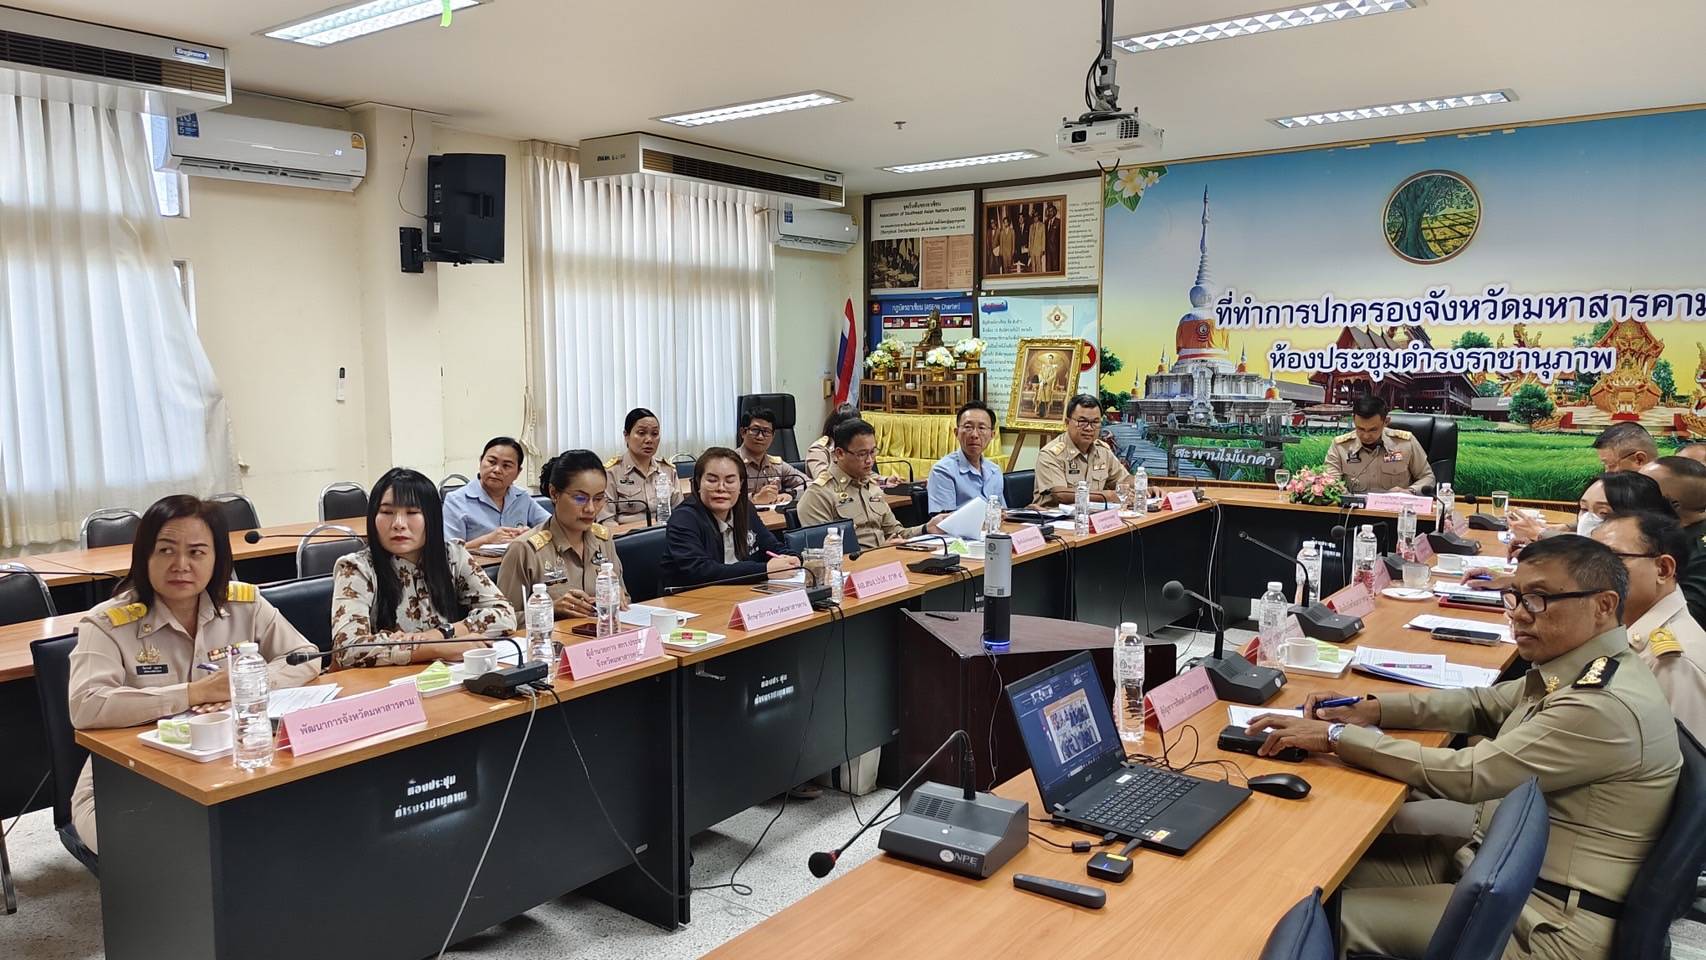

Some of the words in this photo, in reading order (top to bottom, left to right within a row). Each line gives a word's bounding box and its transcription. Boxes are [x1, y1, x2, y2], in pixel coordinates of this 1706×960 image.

[1270, 344, 1612, 378] ห้องประชุมดำรงราชานุภาพ
[299, 697, 416, 736] พัฒนาการจังหวัดมหาสารคาม
[954, 851, 978, 865] NPE
